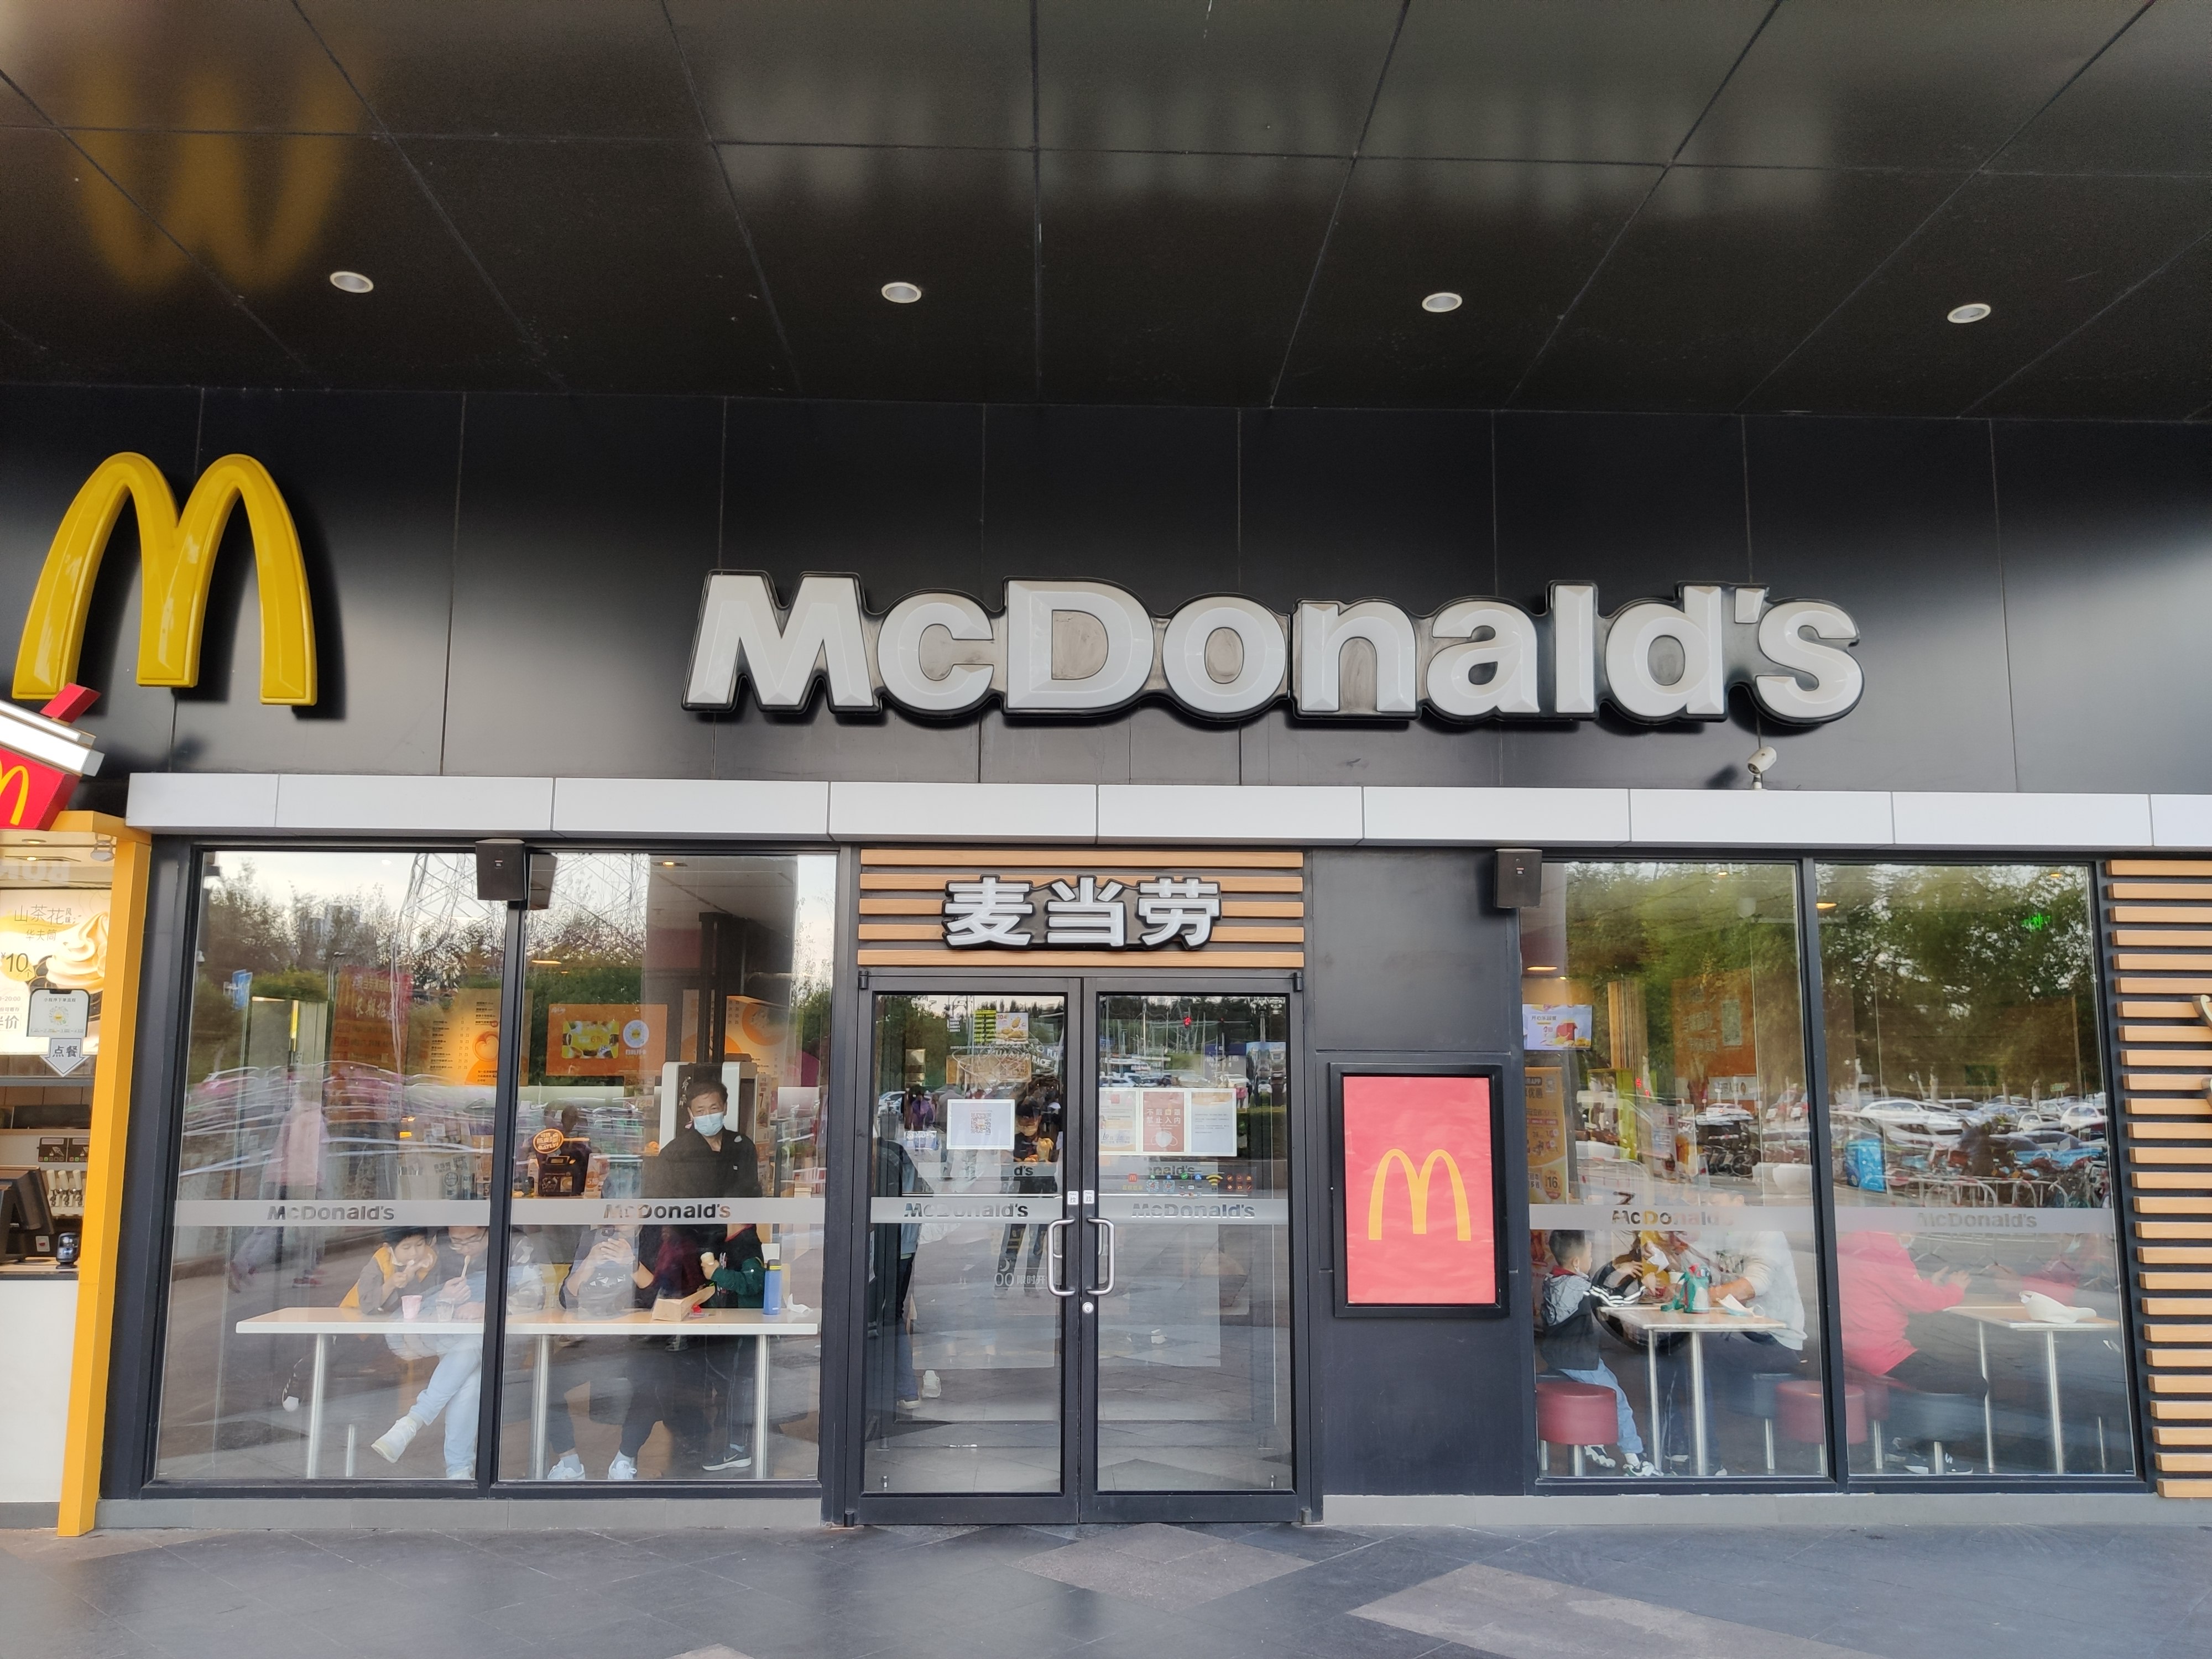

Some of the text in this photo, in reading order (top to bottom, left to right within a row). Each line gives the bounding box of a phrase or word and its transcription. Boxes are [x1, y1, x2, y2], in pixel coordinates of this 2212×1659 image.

[686, 573, 1862, 718] McDonald's
[14, 905, 65, 925] 山茶花
[945, 877, 1219, 946] 麦当劳
[26, 929, 57, 941] 华夫筒
[53, 1045, 78, 1057] 点餐
[1526, 1087, 1543, 1098] 优惠
[1146, 1116, 1181, 1124] 禁止入内
[267, 1205, 394, 1220] McDonald's
[603, 1204, 731, 1219] McDonald's
[904, 1203, 1029, 1217] McDonald's
[1131, 1203, 1255, 1218] McDonald's
[1612, 1210, 1734, 1226] McDonalds
[1916, 1212, 2038, 1228] McDonald's
[1017, 1274, 1047, 1285] 限时开
